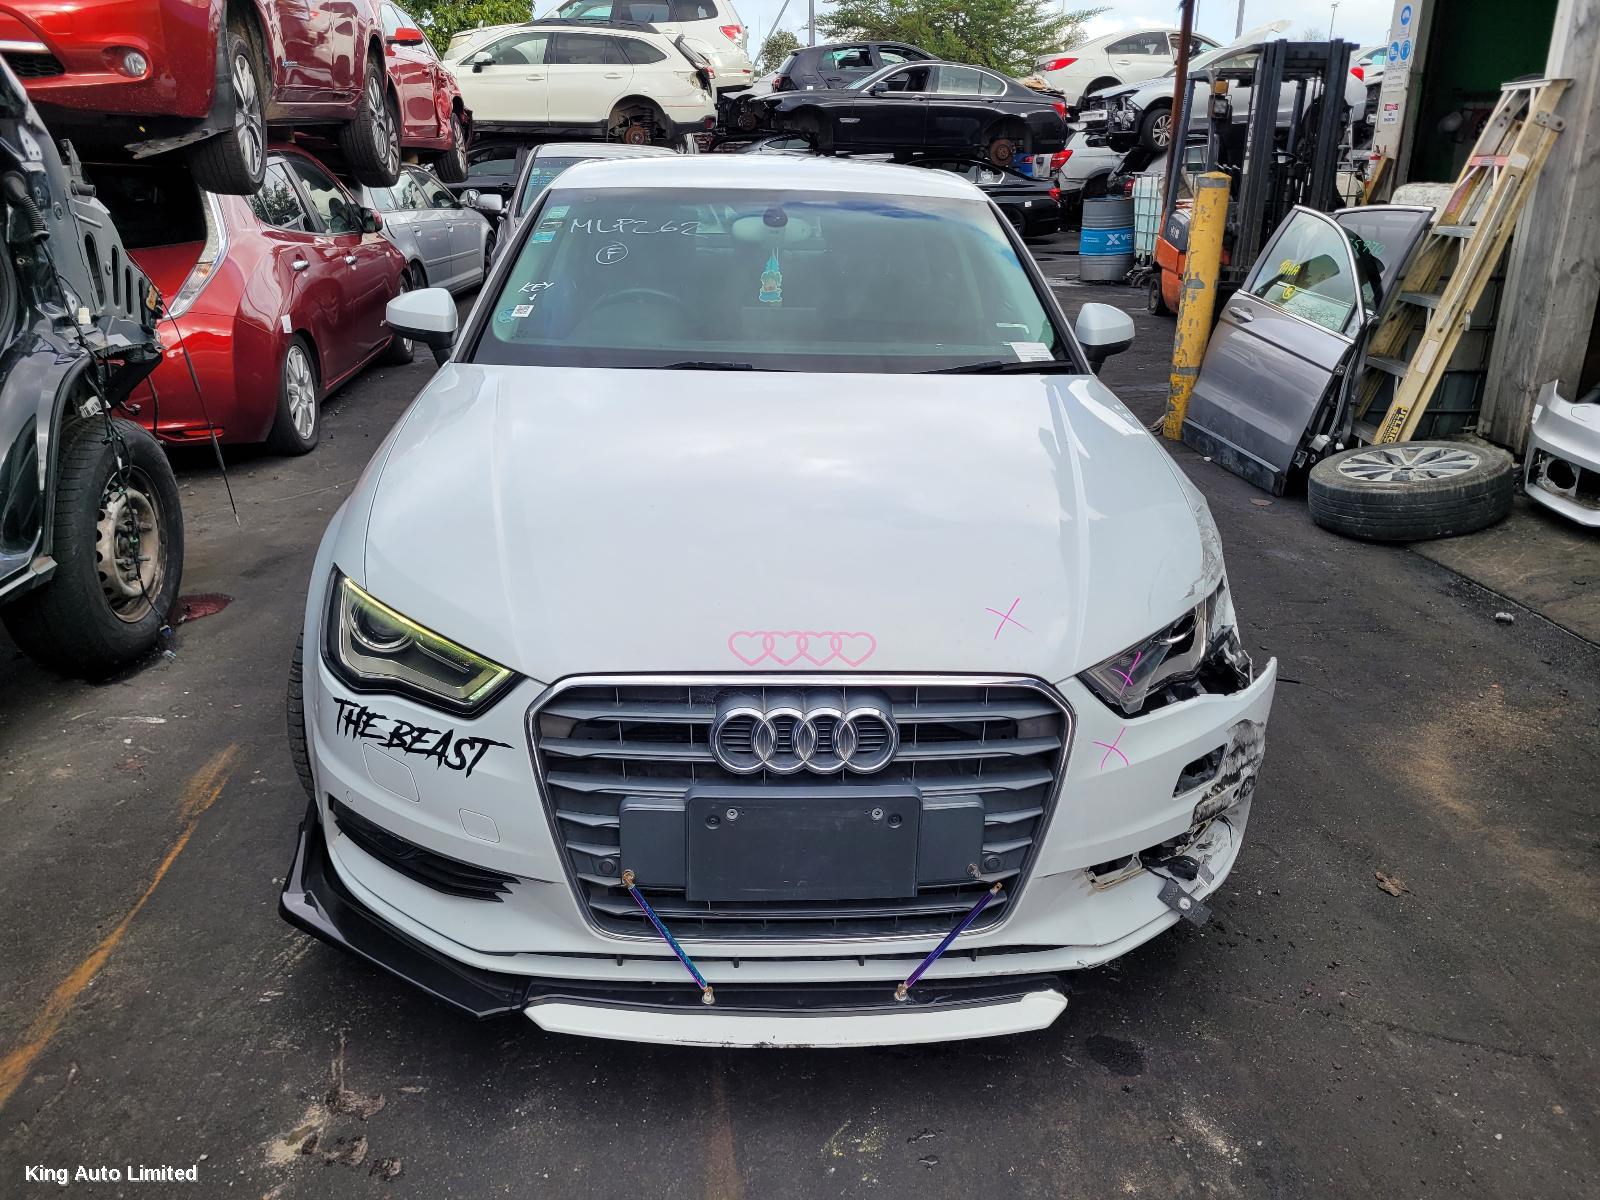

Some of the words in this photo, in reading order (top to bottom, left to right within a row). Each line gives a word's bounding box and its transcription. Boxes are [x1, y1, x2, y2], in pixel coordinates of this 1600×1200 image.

[570, 218, 709, 239] MLP262
[518, 282, 554, 293] KEY
[333, 697, 390, 741] THE
[377, 719, 516, 778] BEAST
